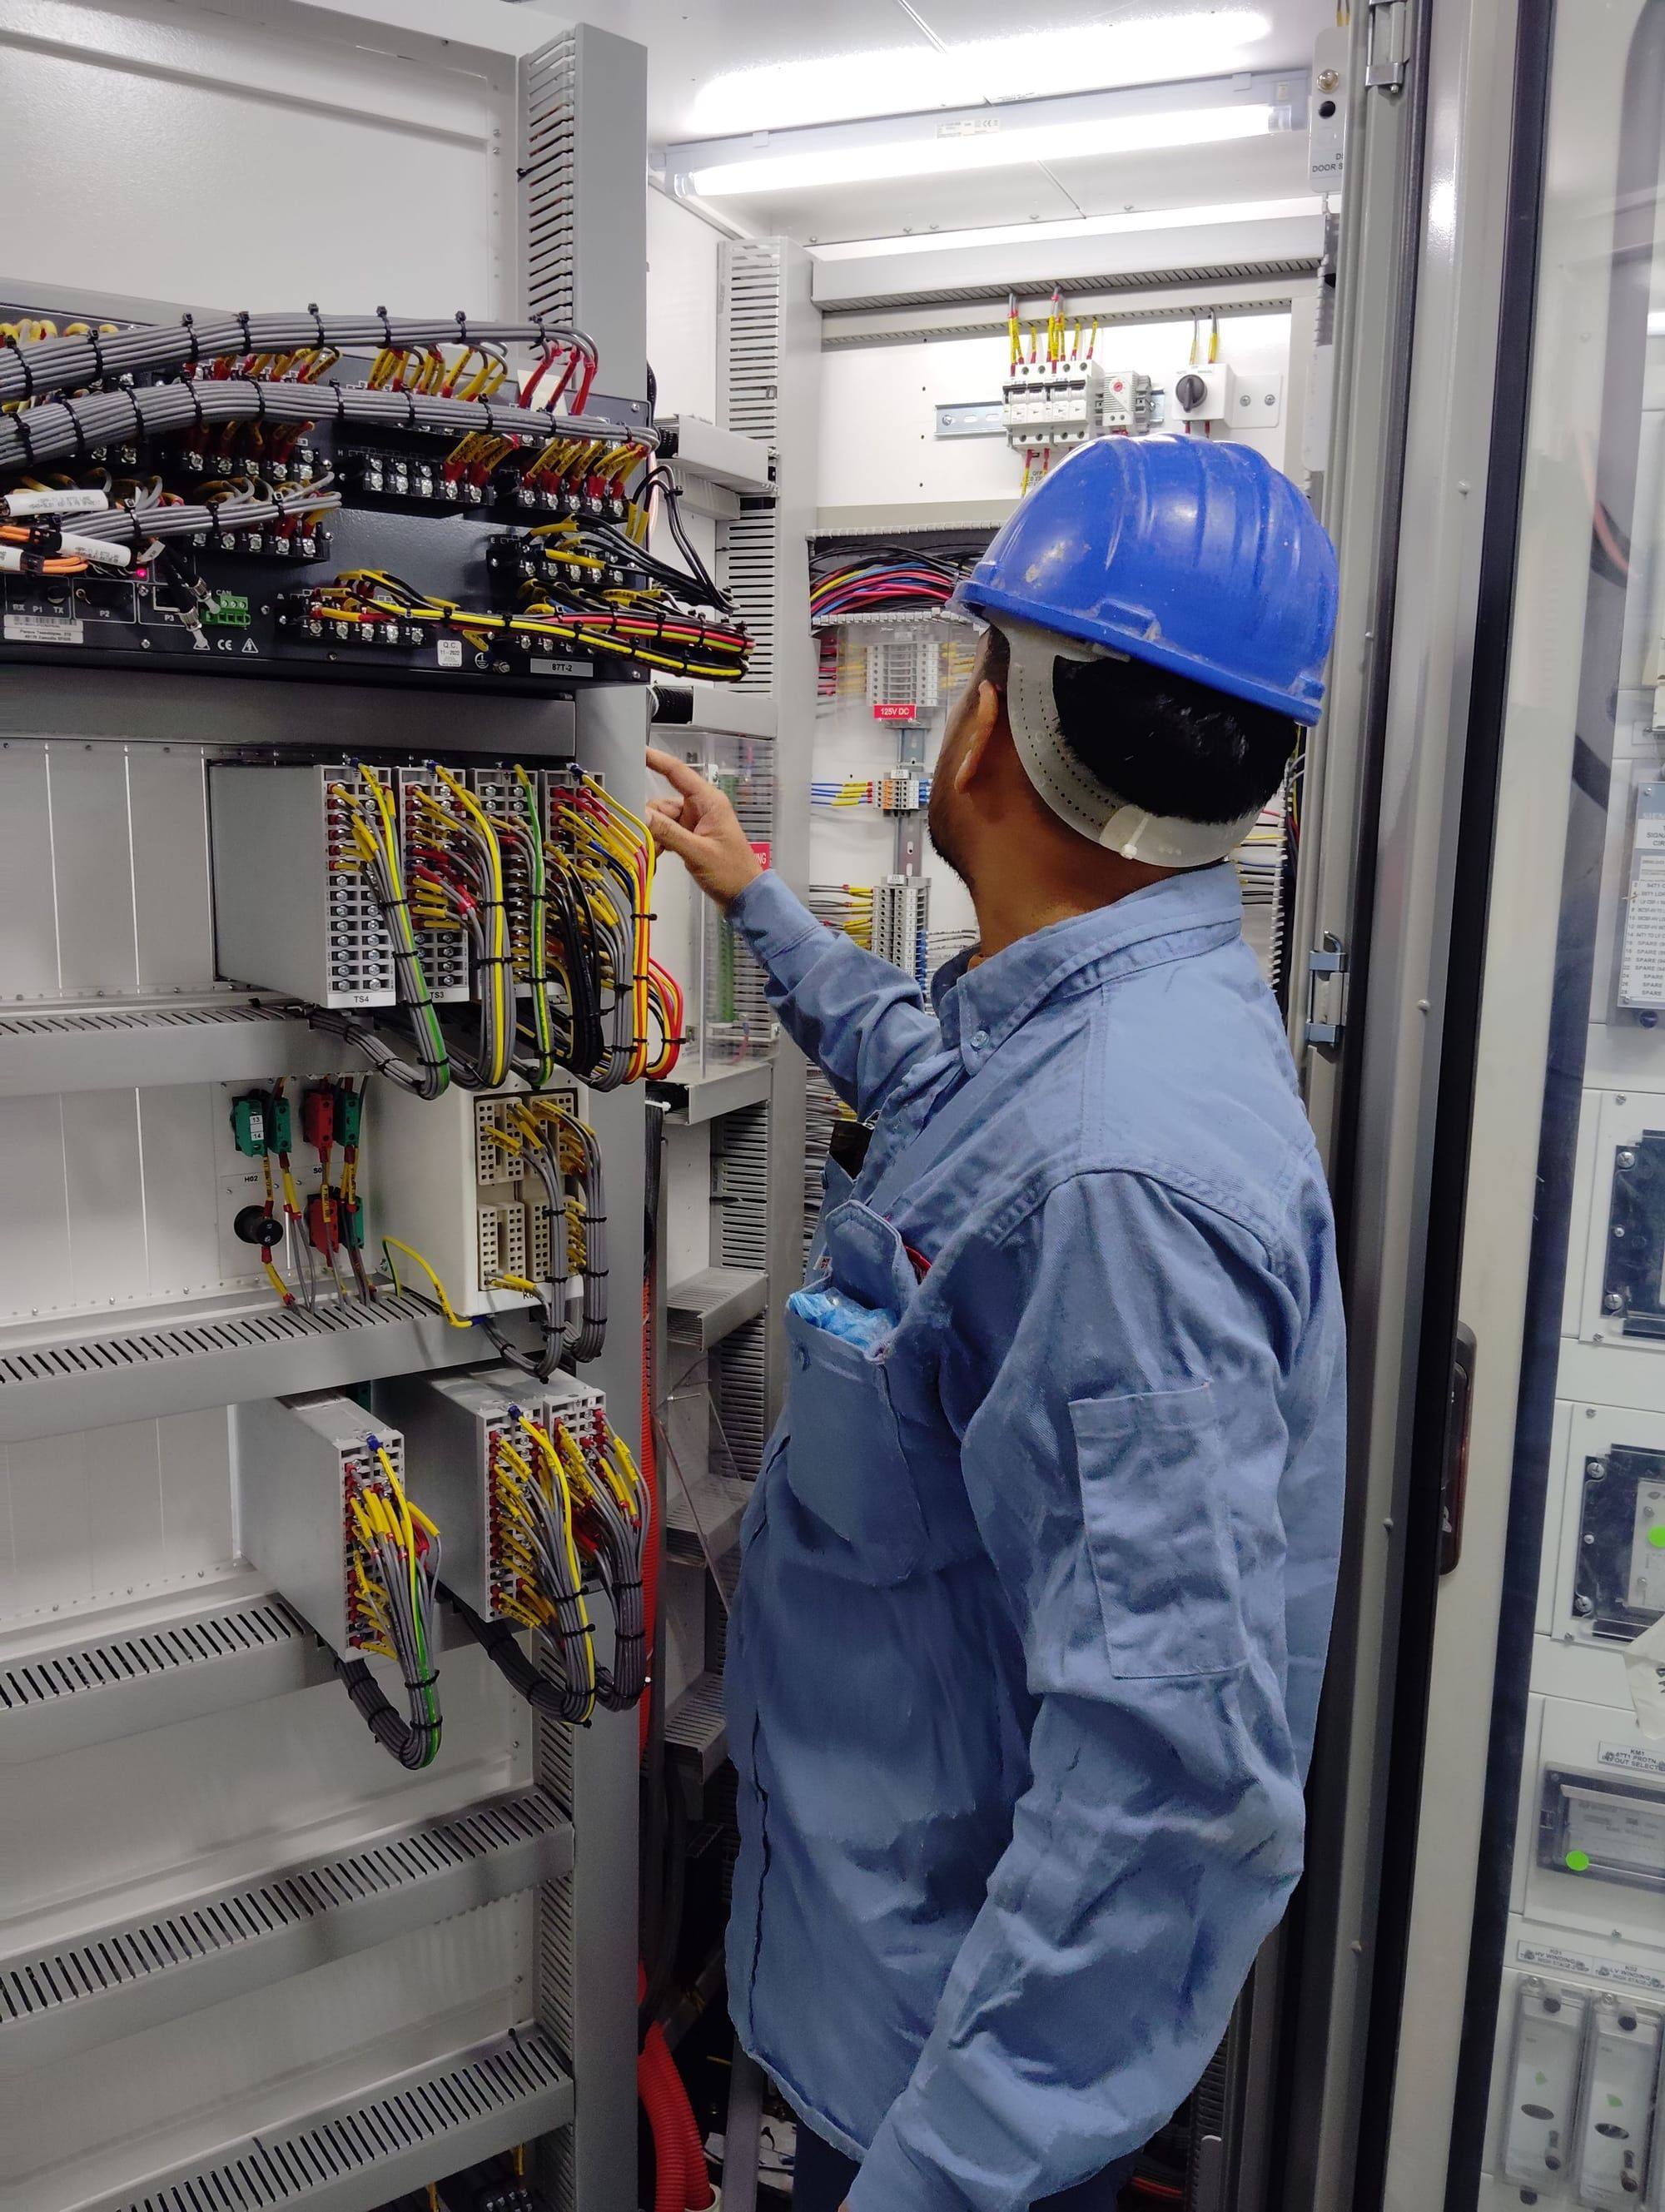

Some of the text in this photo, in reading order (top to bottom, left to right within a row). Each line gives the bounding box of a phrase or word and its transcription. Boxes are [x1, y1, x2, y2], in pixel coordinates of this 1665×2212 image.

[1311, 163, 1336, 173] DOOR
[12, 604, 64, 614] RX P1 TX
[99, 609, 111, 618] P2
[551, 663, 573, 672] 87T-2
